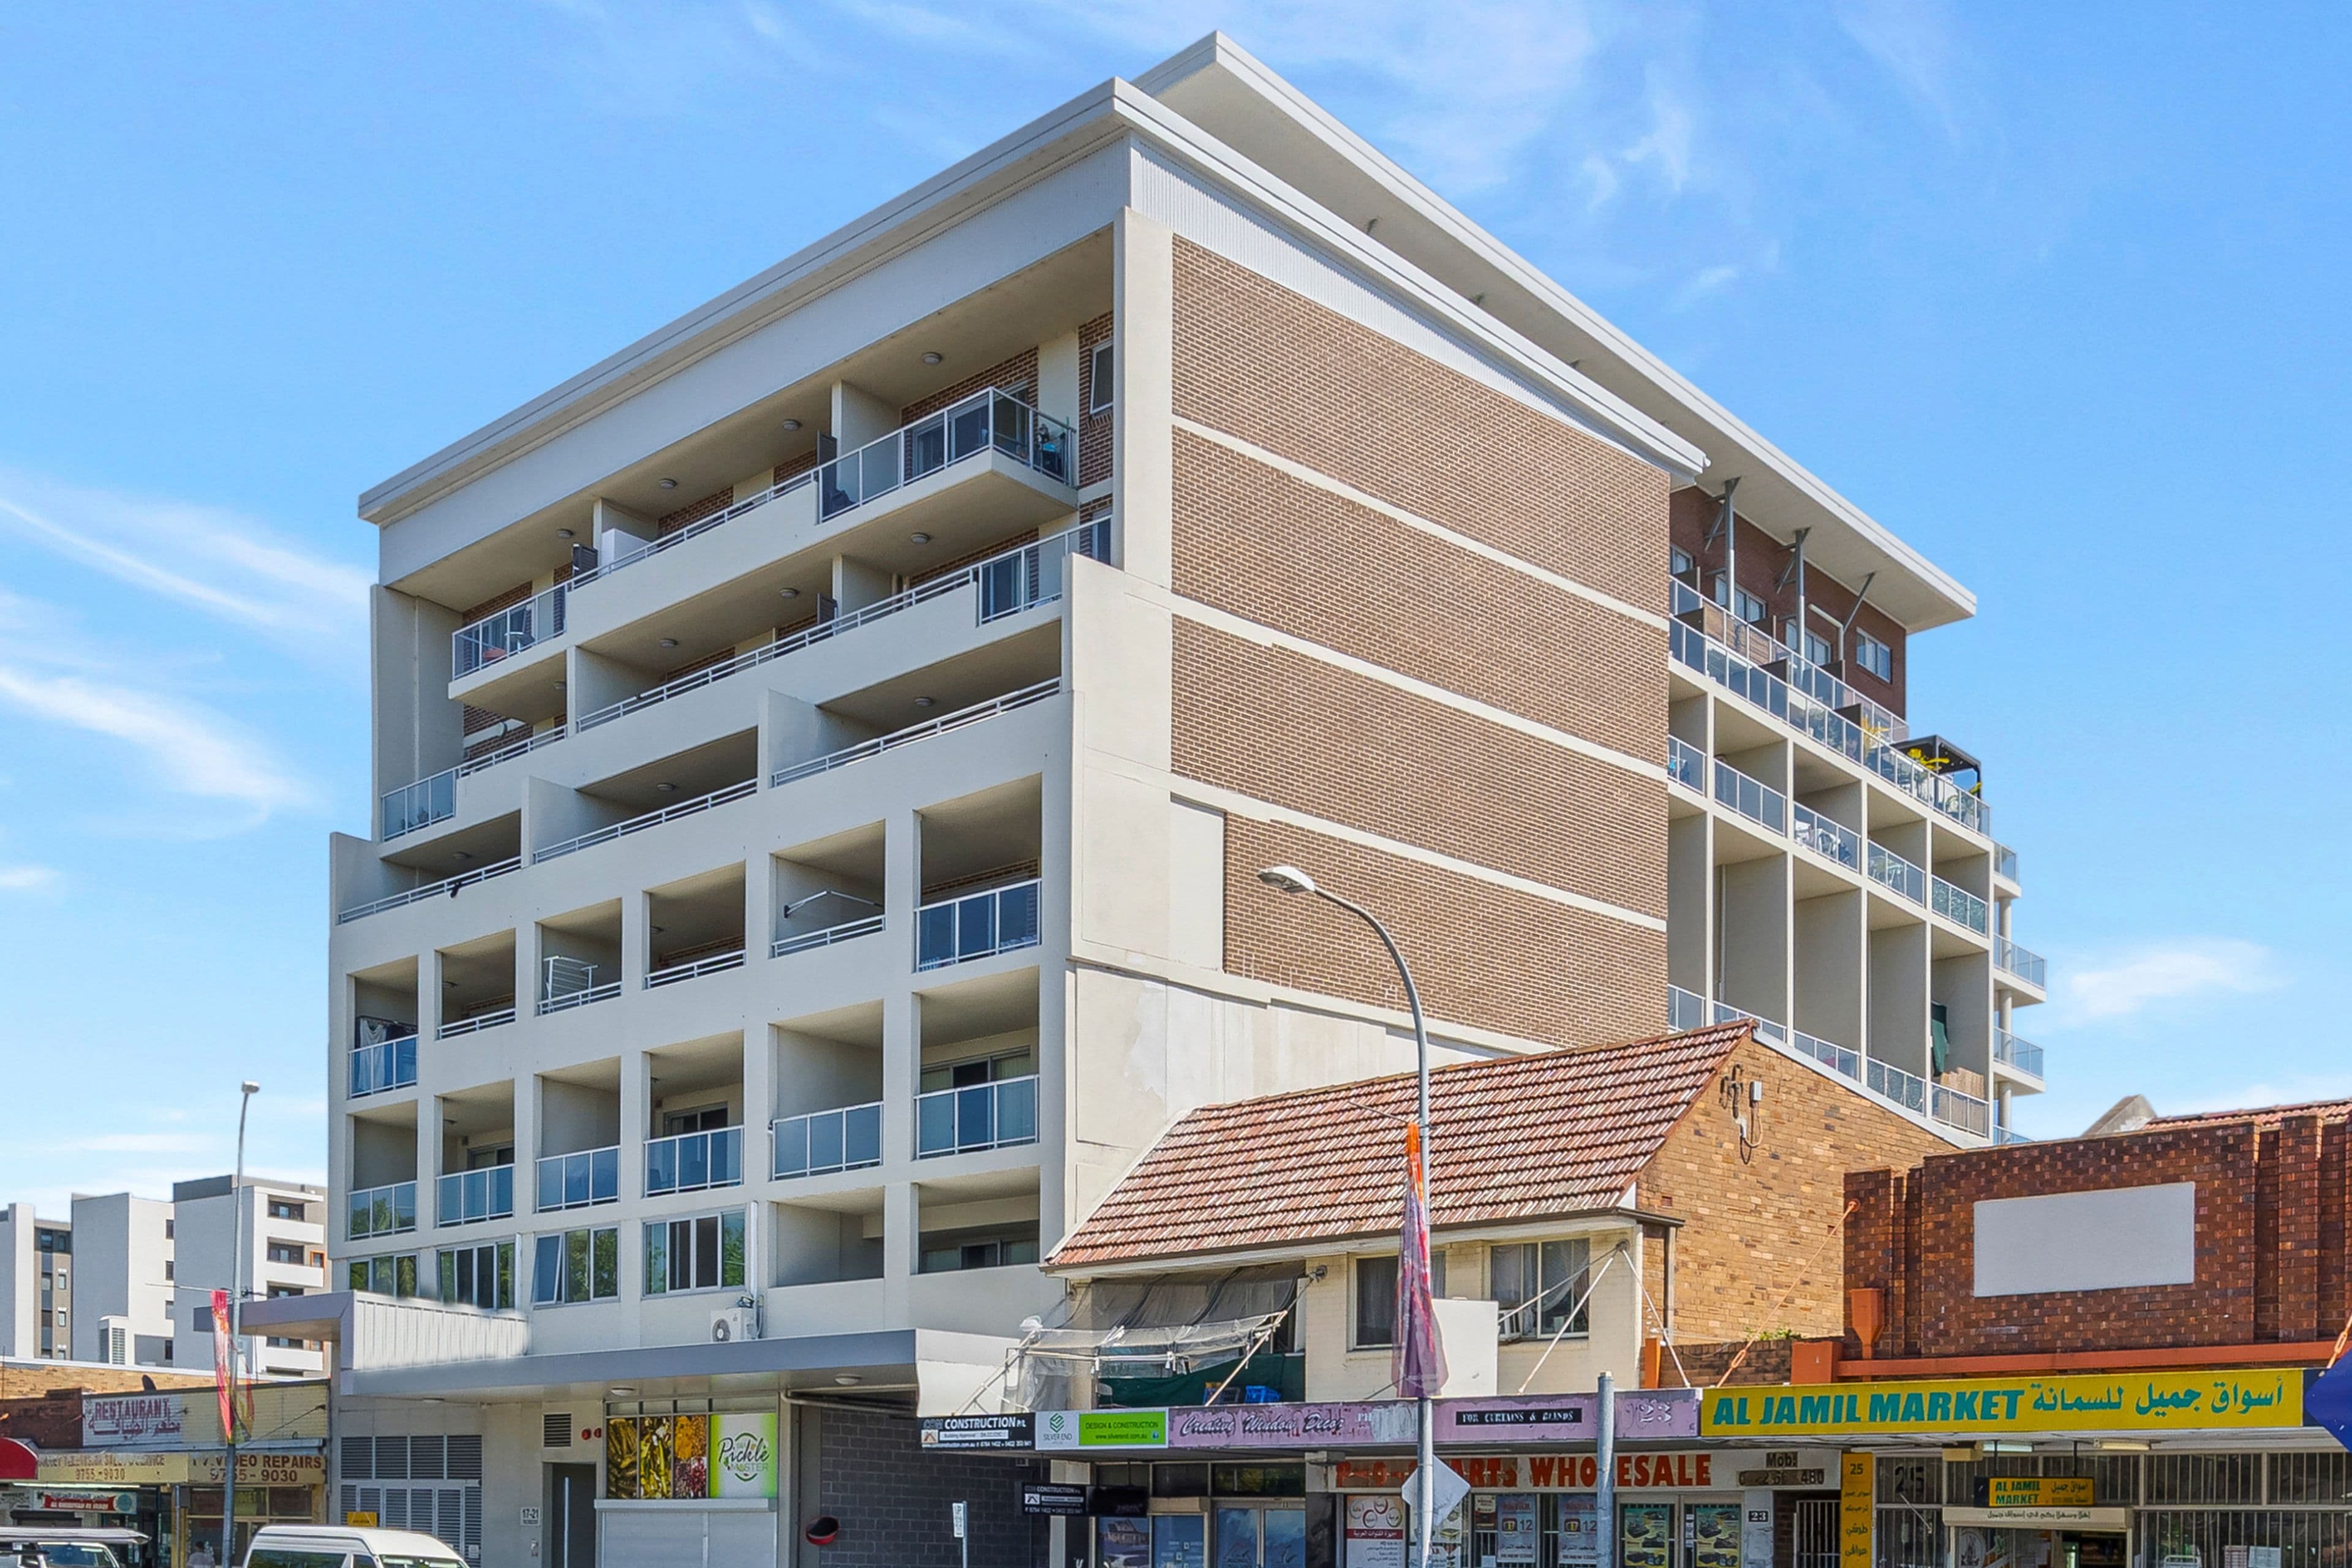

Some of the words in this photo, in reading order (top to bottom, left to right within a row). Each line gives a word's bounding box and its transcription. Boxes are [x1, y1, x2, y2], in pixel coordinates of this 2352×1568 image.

[2136, 1382, 2202, 1417] جميل
[95, 1398, 170, 1420] RESTAURANT
[1713, 1397, 1751, 1425] AL
[1759, 1394, 1861, 1425] JAMIL
[1868, 1389, 2024, 1422] MARKET
[944, 1417, 1016, 1430] CONSTRUCTION
[1463, 1413, 1479, 1423] FOR
[718, 1437, 770, 1463] Pickle
[263, 1455, 322, 1469] REPAIRS
[1529, 1454, 1711, 1487] WHOESALE
[1850, 1463, 1864, 1475] 25
[1996, 1481, 2008, 1491] AL
[2011, 1480, 2041, 1491] JAMIL
[1996, 1494, 2040, 1505] MARKET
[1751, 1512, 1766, 1521] 23
[1520, 1519, 1533, 1531] 12
[1583, 1520, 1597, 1531] 12
